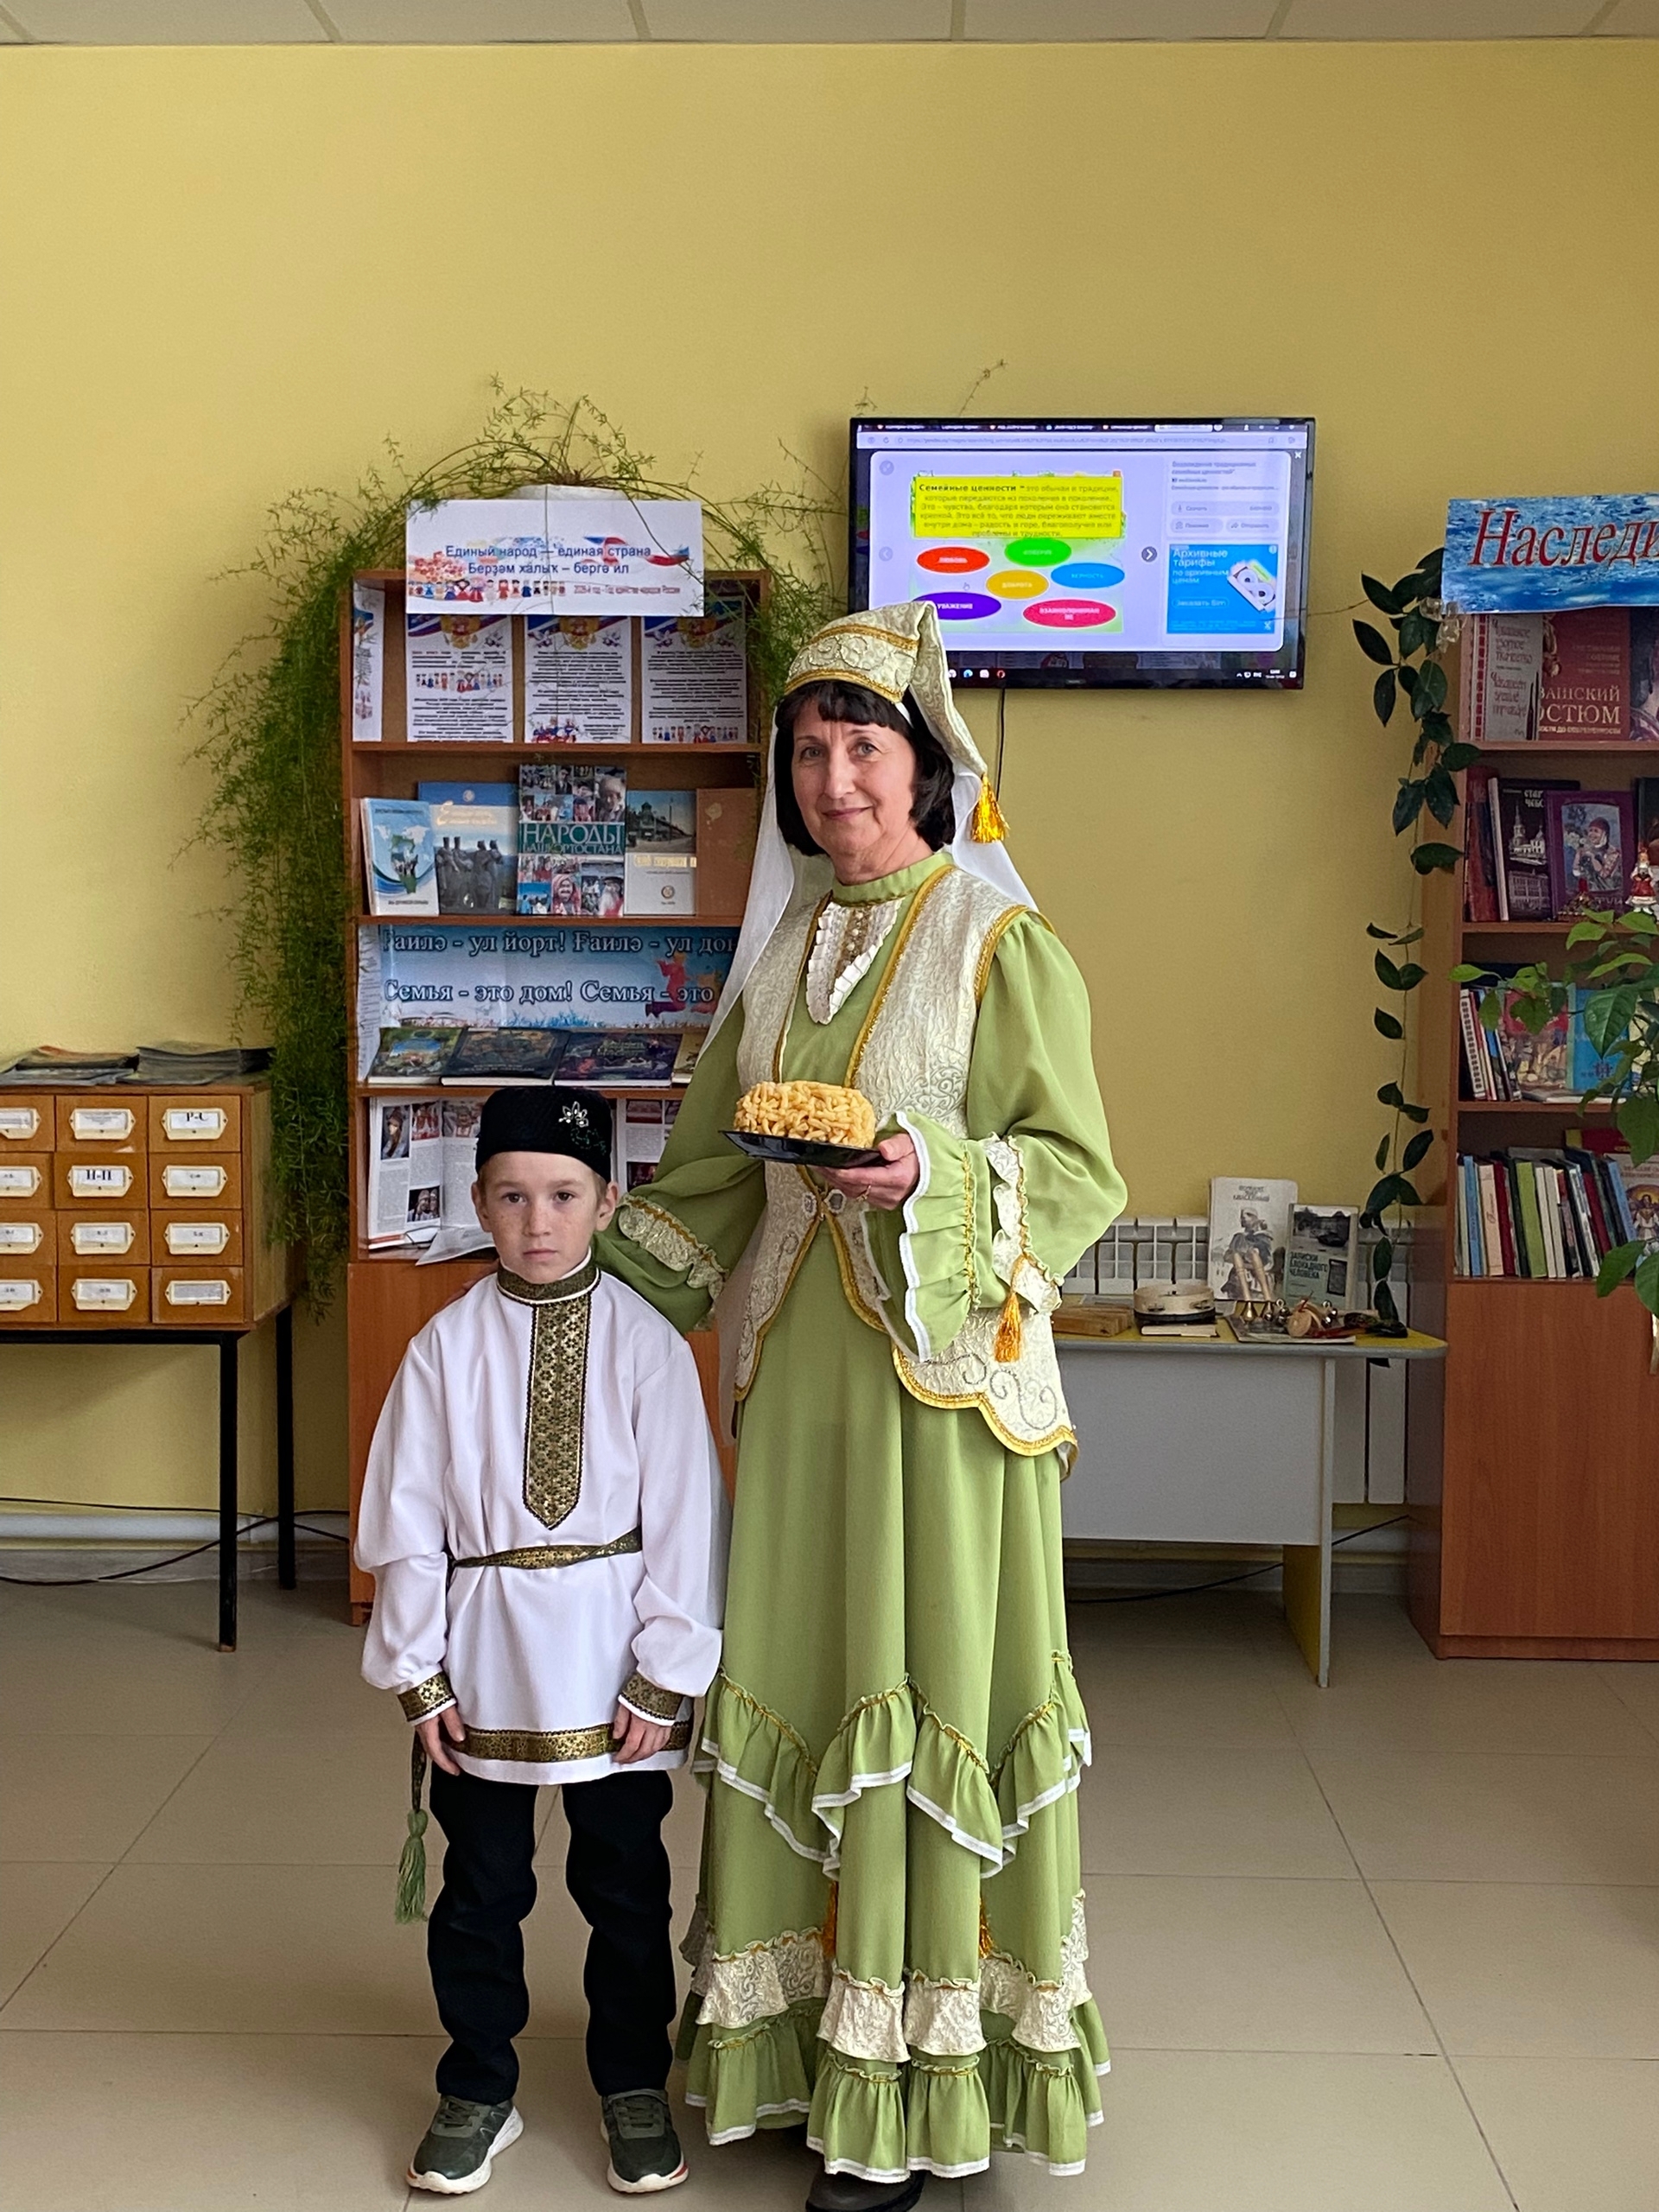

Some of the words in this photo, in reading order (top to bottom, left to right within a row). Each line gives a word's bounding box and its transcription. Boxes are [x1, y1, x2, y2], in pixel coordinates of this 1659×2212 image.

[446, 545, 496, 559] Единый
[499, 548, 537, 559] народ
[557, 548, 603, 558] единая
[607, 547, 652, 559] страна
[1173, 549, 1228, 559] Архивные
[613, 564, 629, 574] ил
[1173, 558, 1216, 569] тарифы
[522, 823, 621, 845] НАРОДЫ
[522, 842, 623, 855] БАШКОРТОСТАНА
[469, 936, 497, 957] ул
[505, 931, 566, 957] йорт!
[665, 937, 691, 957] ул
[385, 979, 453, 1001] Семья
[474, 985, 514, 1001] это
[519, 981, 573, 1005] дом!
[581, 980, 654, 1002] Семья
[677, 987, 714, 1002] это
